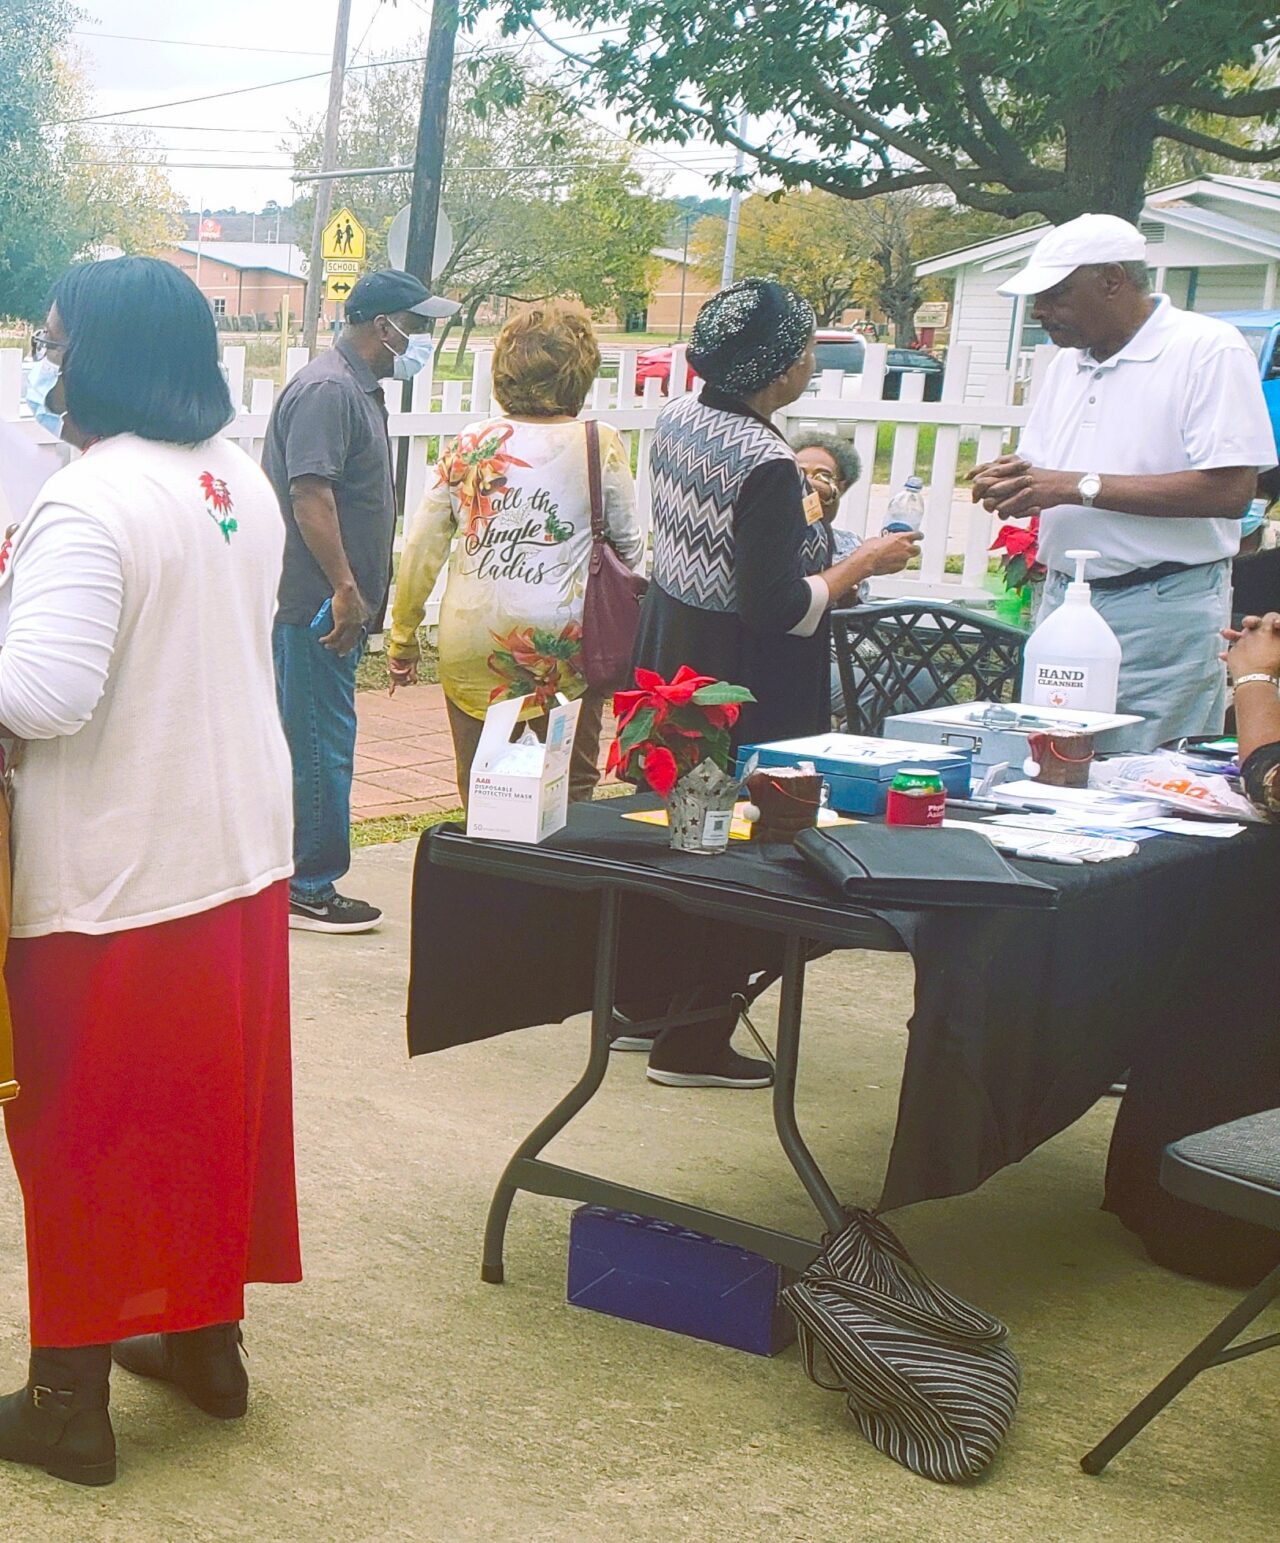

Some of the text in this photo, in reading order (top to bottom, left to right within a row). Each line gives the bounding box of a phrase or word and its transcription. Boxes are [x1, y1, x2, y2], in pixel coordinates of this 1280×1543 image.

[328, 263, 357, 271] SCHOOL
[491, 487, 559, 514] all the
[466, 514, 563, 562] Jingle
[468, 549, 562, 584] ladies
[1039, 668, 1084, 680] HAND
[1037, 679, 1083, 688] CLEANSER
[475, 784, 513, 792] DISPOSABLE
[474, 790, 512, 798] PROTECTIVE
[473, 823, 483, 831] 50
